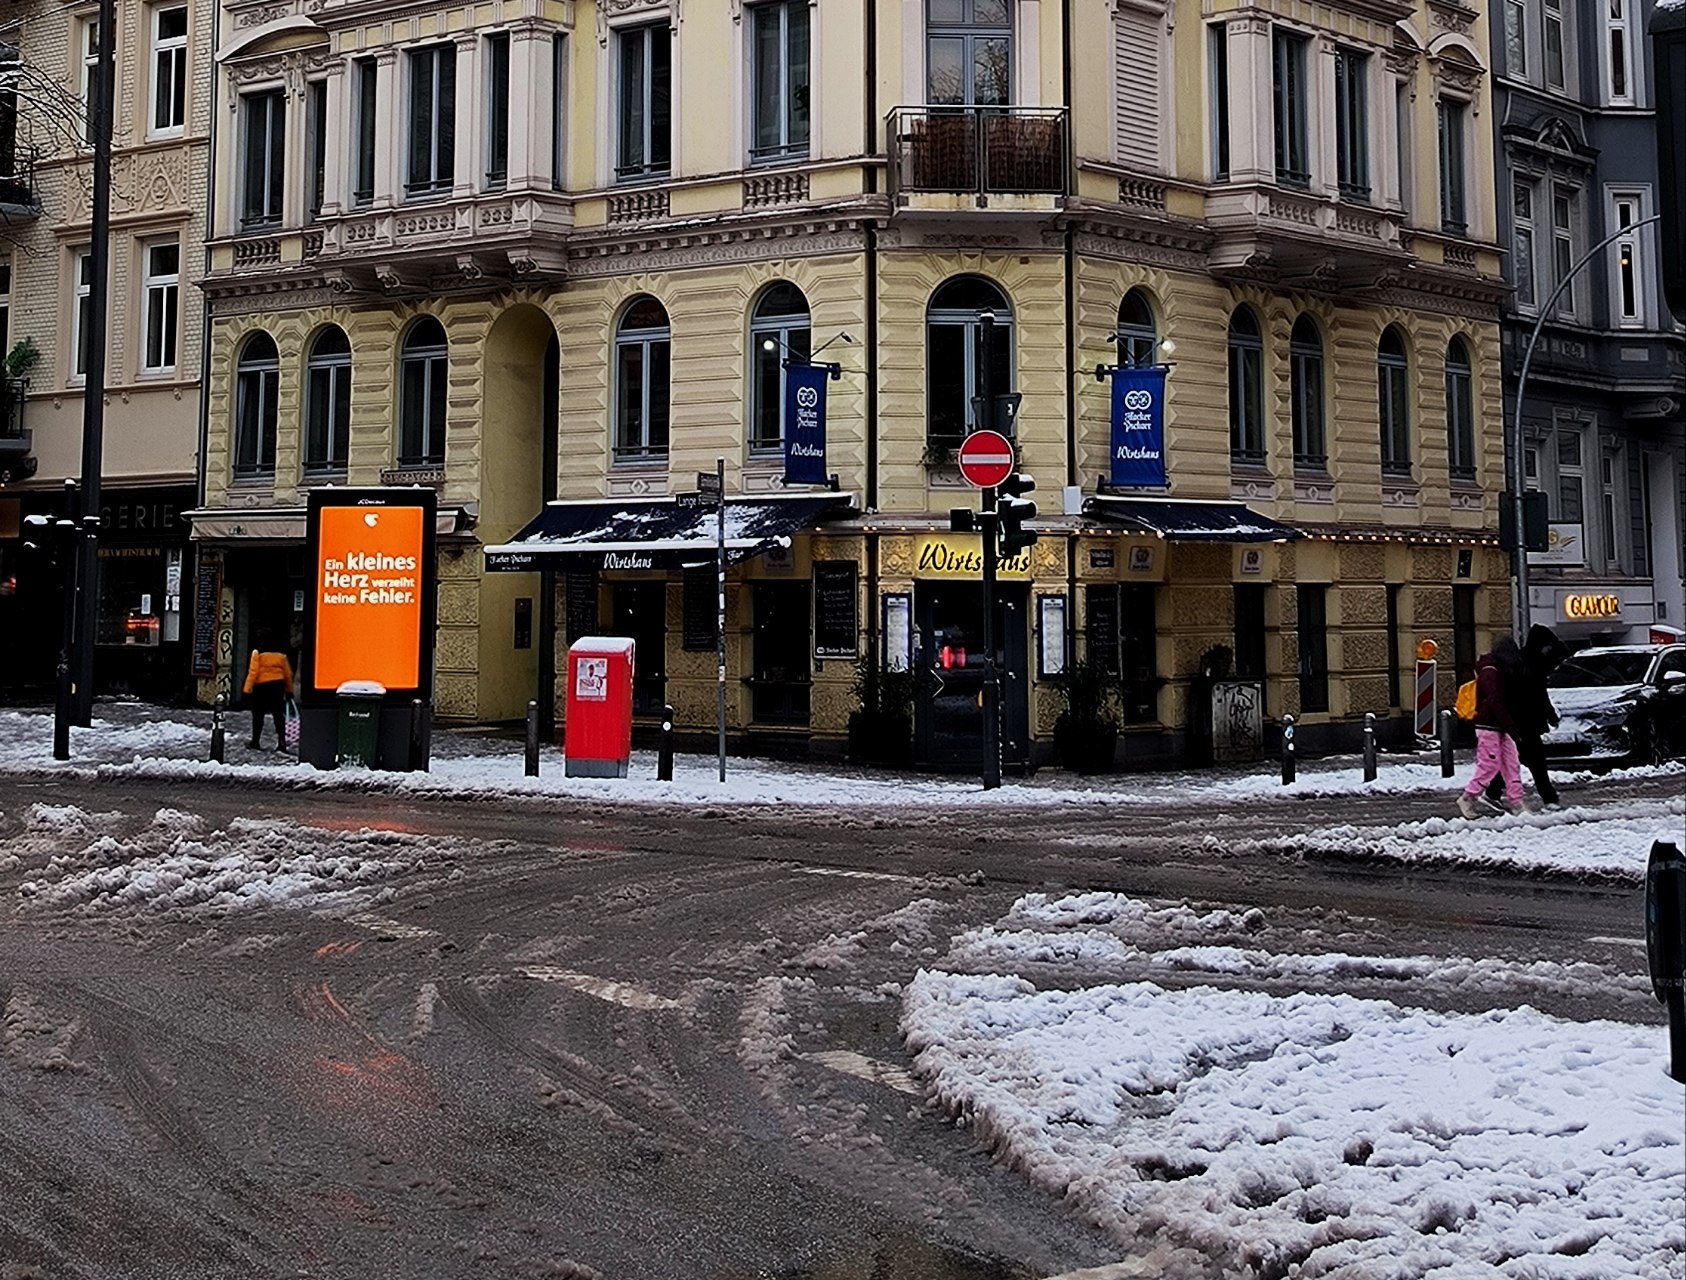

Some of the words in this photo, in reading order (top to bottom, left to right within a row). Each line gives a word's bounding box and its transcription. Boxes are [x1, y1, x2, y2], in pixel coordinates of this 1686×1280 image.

[1116, 445, 1160, 459] Wirtshaus
[325, 559, 344, 570] Ein
[346, 551, 416, 571] kleines
[603, 551, 652, 569] Wirtshaus
[918, 543, 1030, 572] Wirtsaus
[324, 570, 369, 588] Herz
[371, 577, 415, 588] verzeiht
[323, 592, 357, 604] keine
[360, 588, 415, 604] Fehler.
[1570, 595, 1622, 617] GLAMOUR
